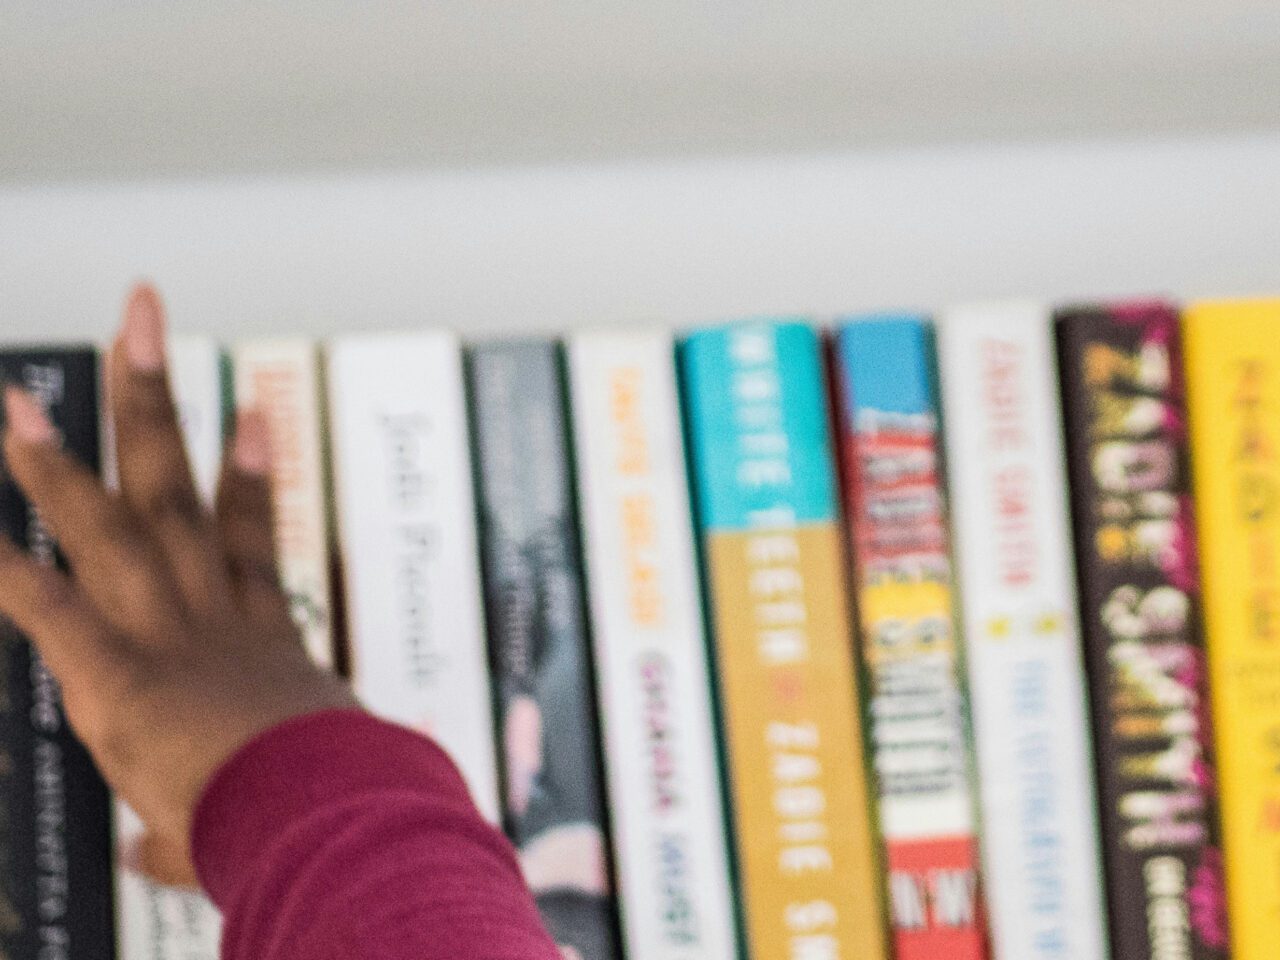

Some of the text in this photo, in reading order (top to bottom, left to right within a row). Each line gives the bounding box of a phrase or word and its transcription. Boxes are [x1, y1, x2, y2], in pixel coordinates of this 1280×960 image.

[1083, 340, 1182, 563] ZADIE
[745, 508, 811, 667] TEETH
[764, 720, 834, 876] ZADIE
[1100, 585, 1211, 851] SMITH
